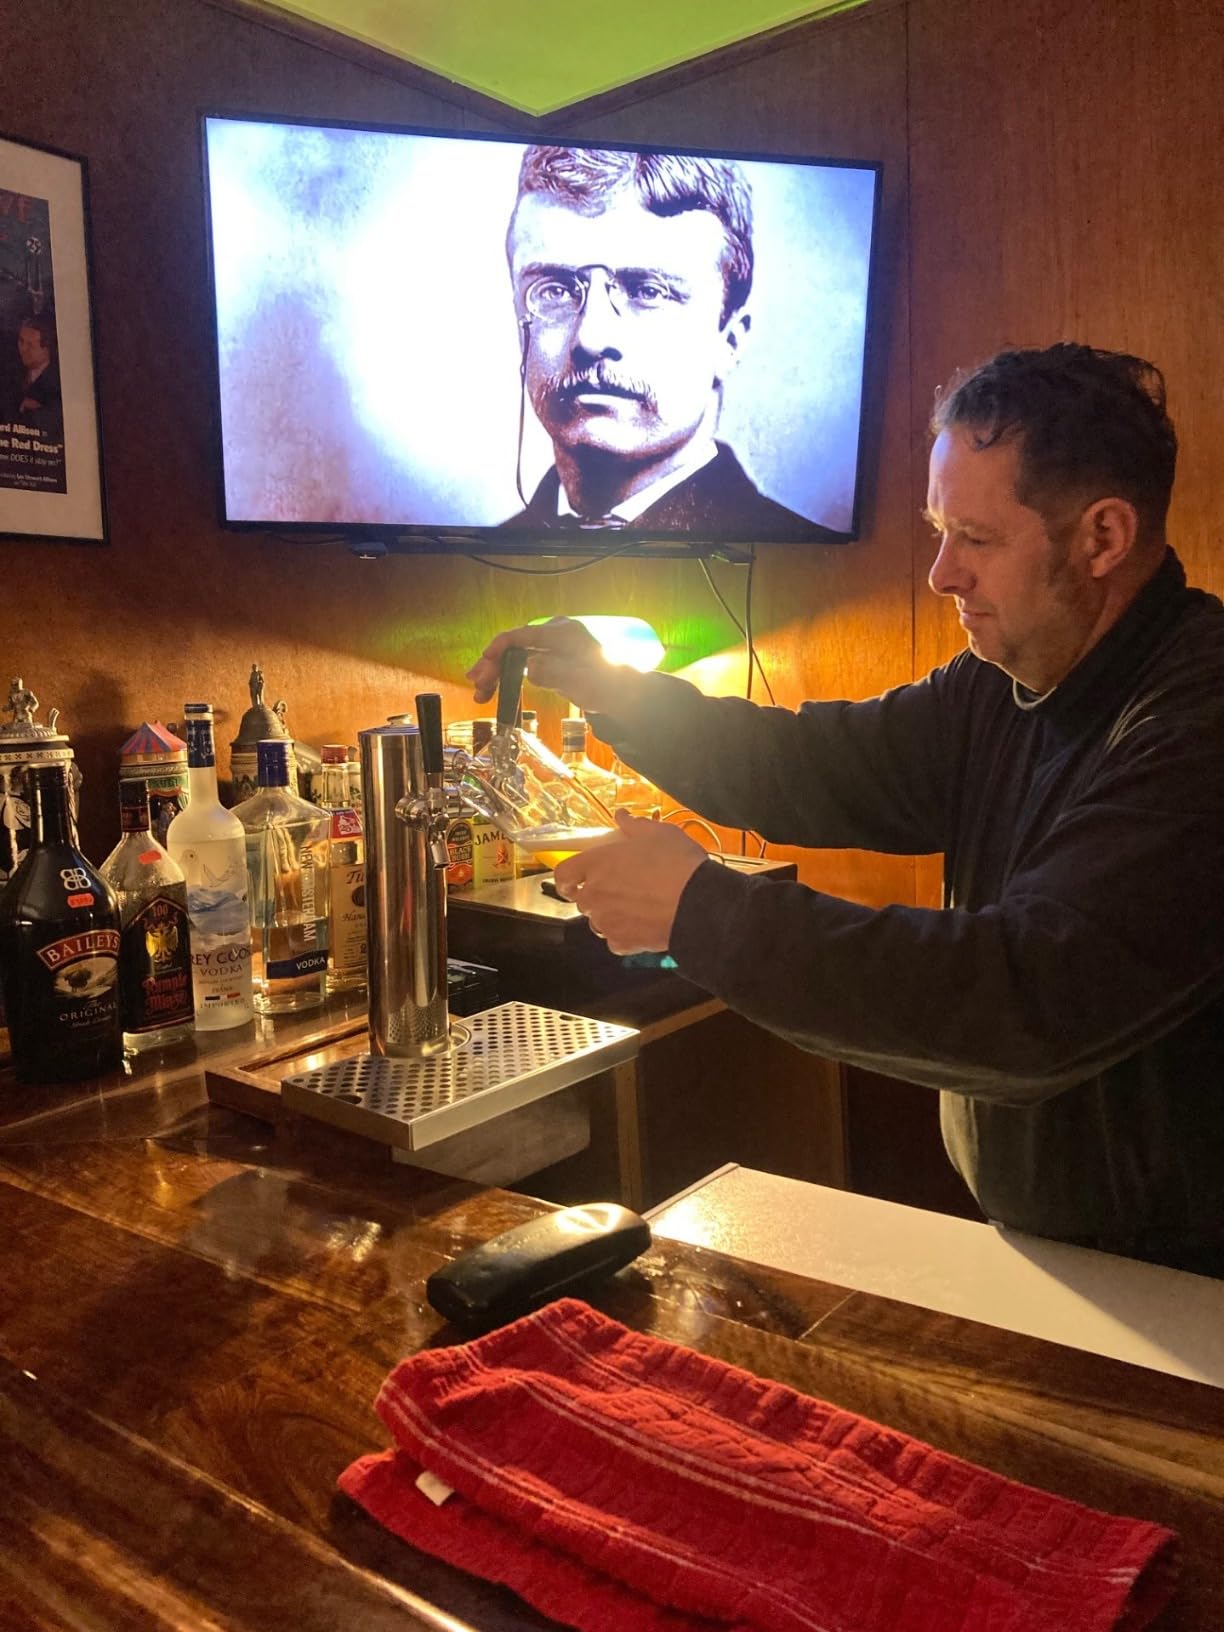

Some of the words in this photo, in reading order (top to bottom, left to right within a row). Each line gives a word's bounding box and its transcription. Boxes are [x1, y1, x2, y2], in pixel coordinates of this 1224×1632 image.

[11, 438, 31, 450] Red
[151, 904, 169, 917] 100
[46, 932, 120, 963] BAILEYS
[200, 963, 243, 977] VODKA
[296, 958, 327, 971] VODKA
[58, 999, 118, 1022] ORIGINAL
